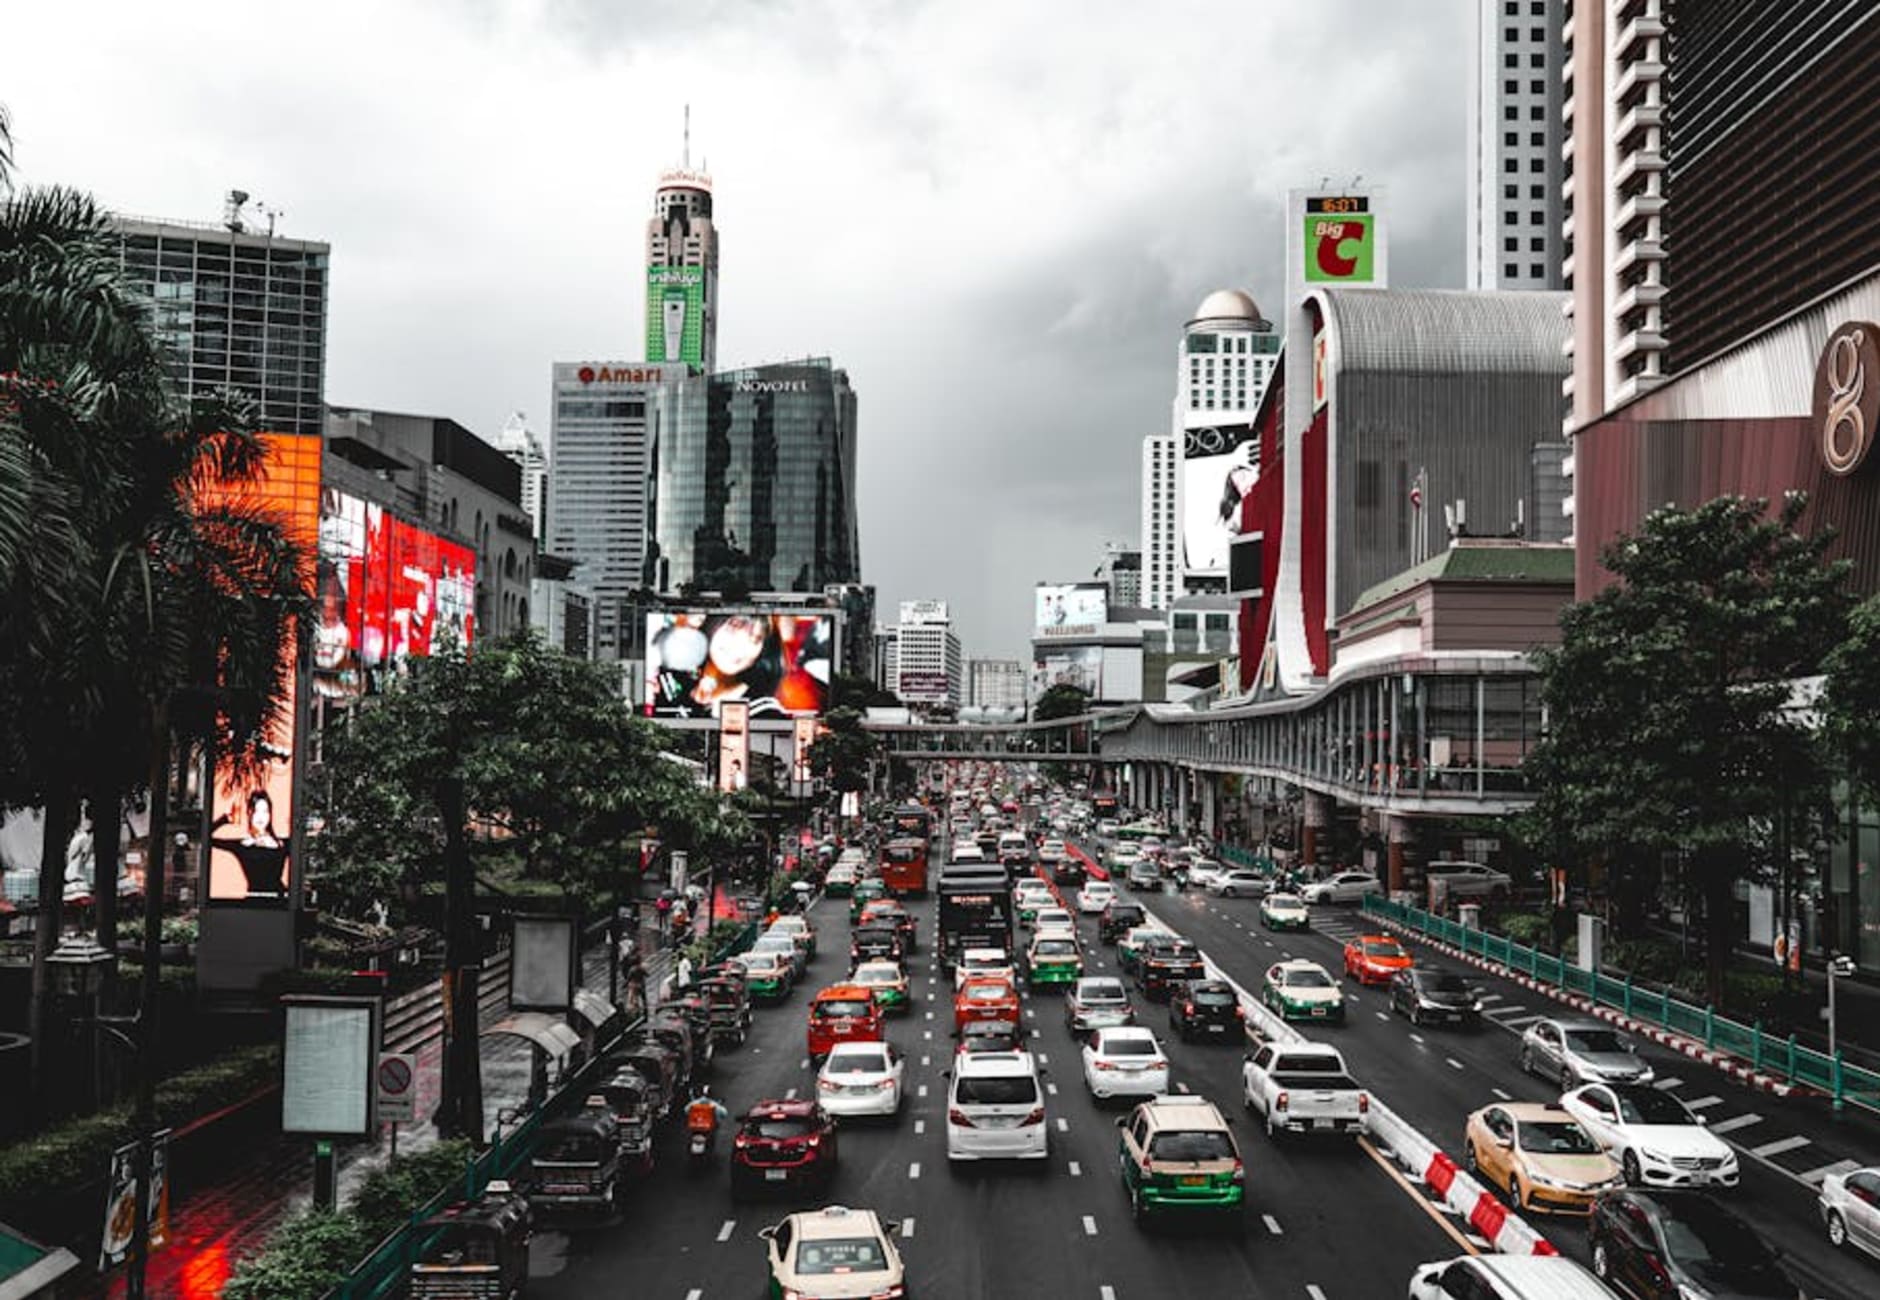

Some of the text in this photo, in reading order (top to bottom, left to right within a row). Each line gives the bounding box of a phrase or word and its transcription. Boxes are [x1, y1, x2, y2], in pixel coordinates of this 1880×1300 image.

[1315, 221, 1364, 277] Big C
[597, 367, 661, 383] Amari
[735, 380, 808, 393] NOVOTEL
